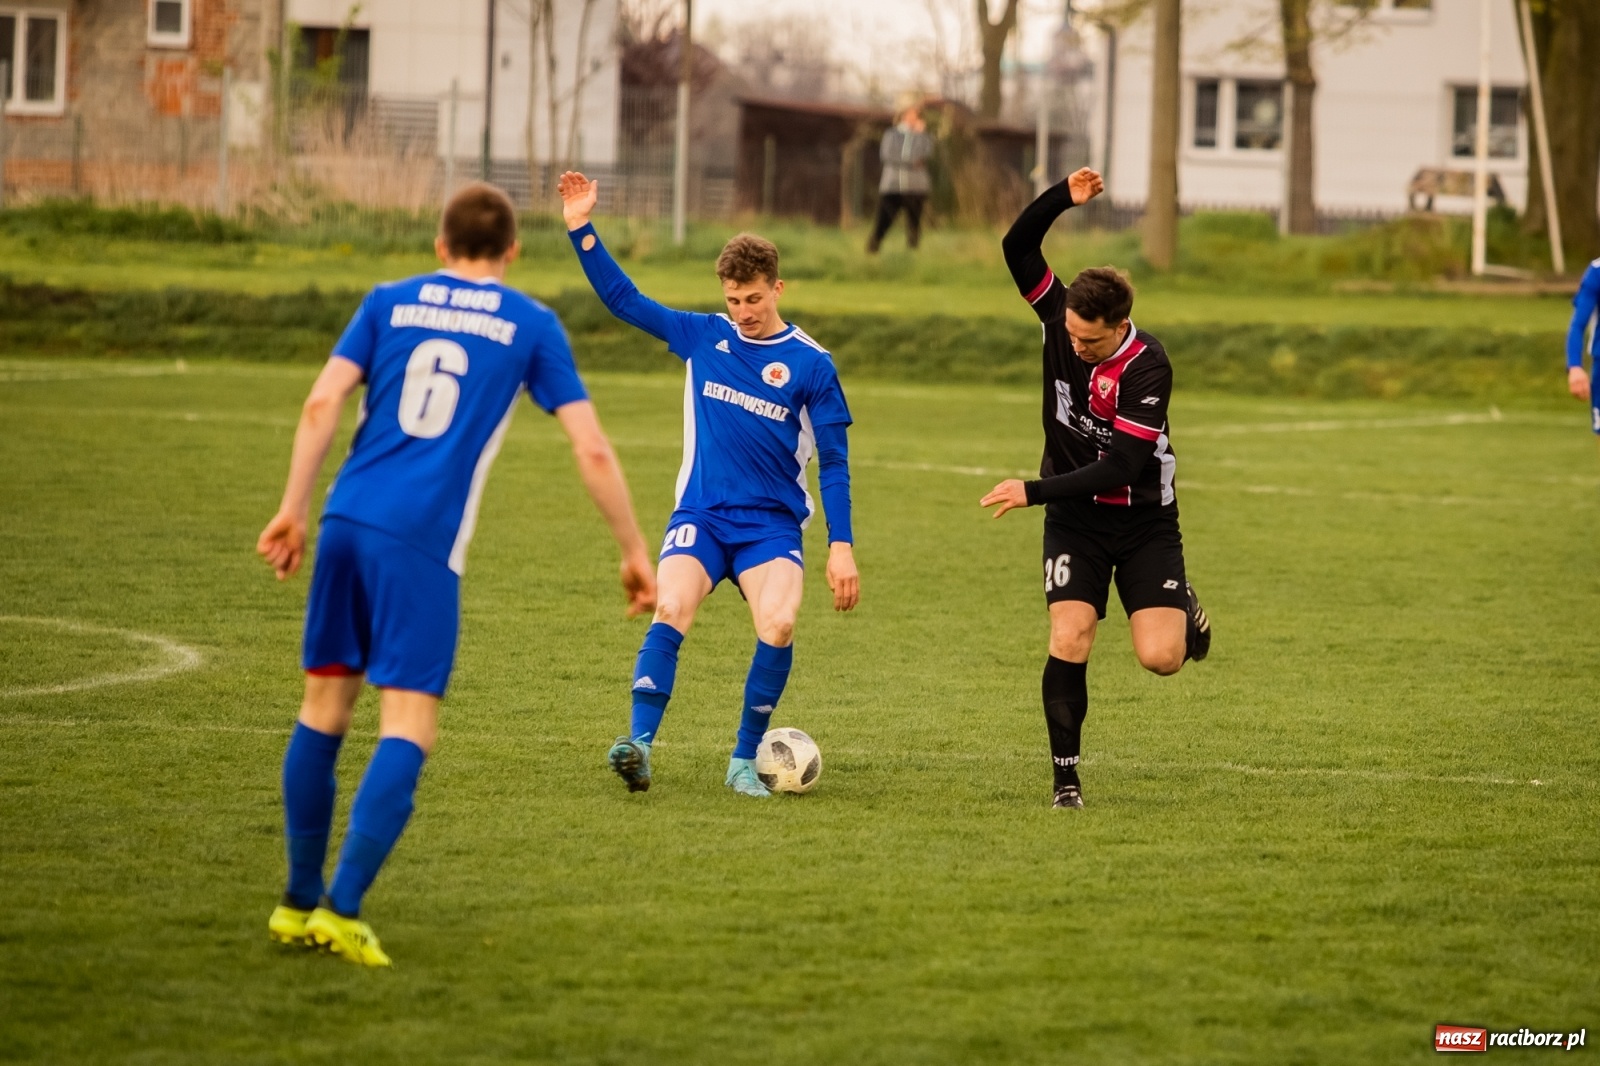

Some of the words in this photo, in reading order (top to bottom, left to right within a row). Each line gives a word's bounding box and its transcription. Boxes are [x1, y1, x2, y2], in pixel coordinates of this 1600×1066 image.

[398, 338, 469, 439] 6
[660, 523, 697, 556] 20
[1045, 553, 1071, 592] 26
